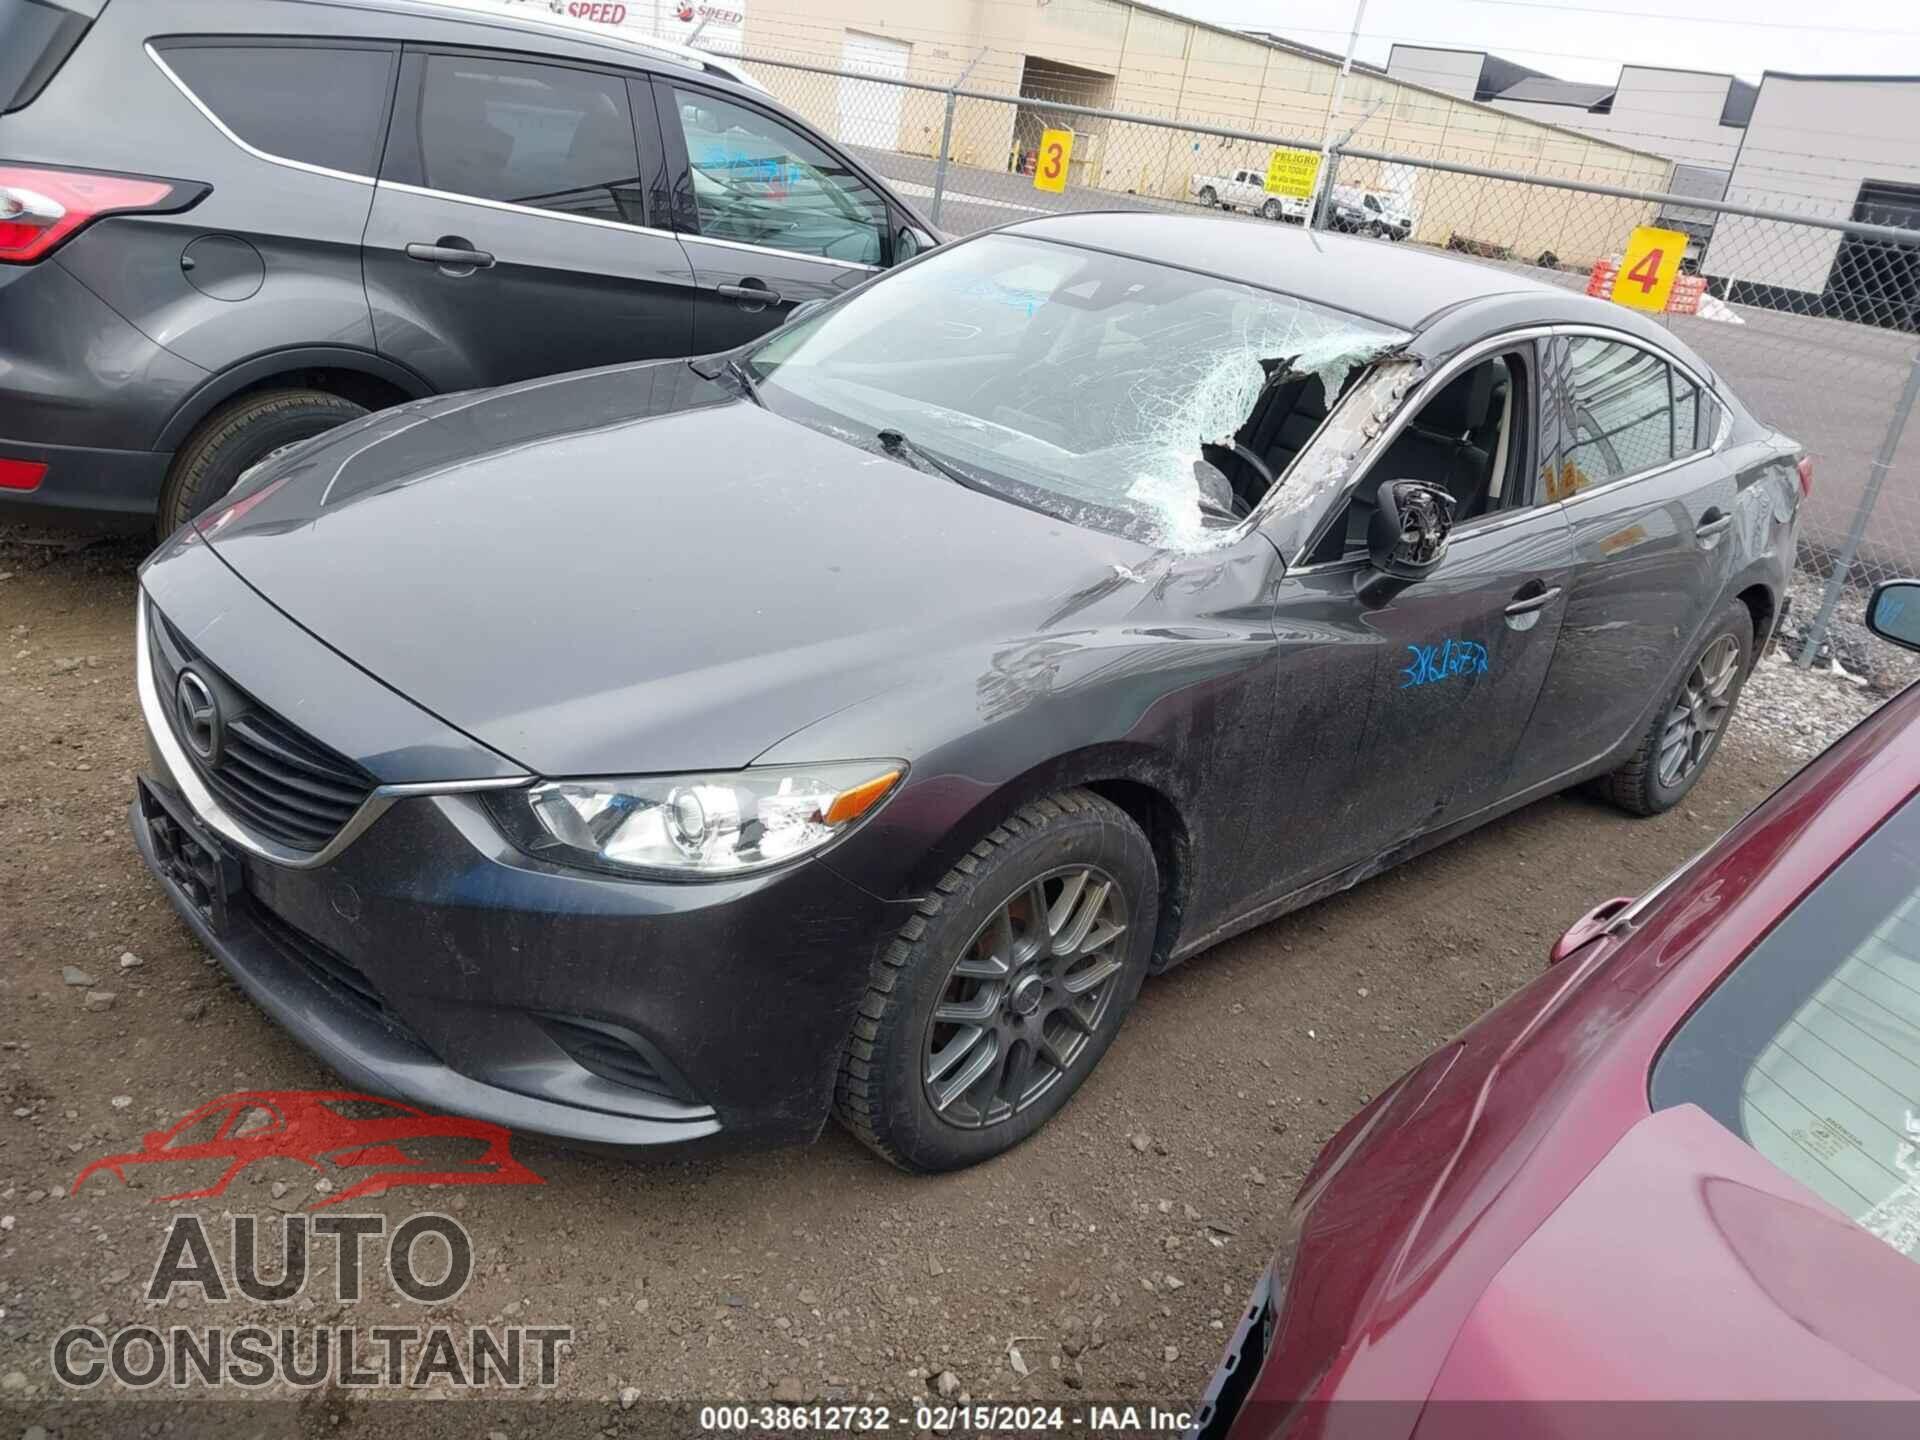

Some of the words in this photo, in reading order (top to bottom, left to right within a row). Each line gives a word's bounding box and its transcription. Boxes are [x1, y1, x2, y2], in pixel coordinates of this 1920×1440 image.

[567, 2, 626, 25] SPEED
[697, 5, 743, 24] SPEED
[1044, 143, 1063, 178] 3
[1274, 151, 1318, 165] PELIGRO
[1627, 248, 1664, 294] 4
